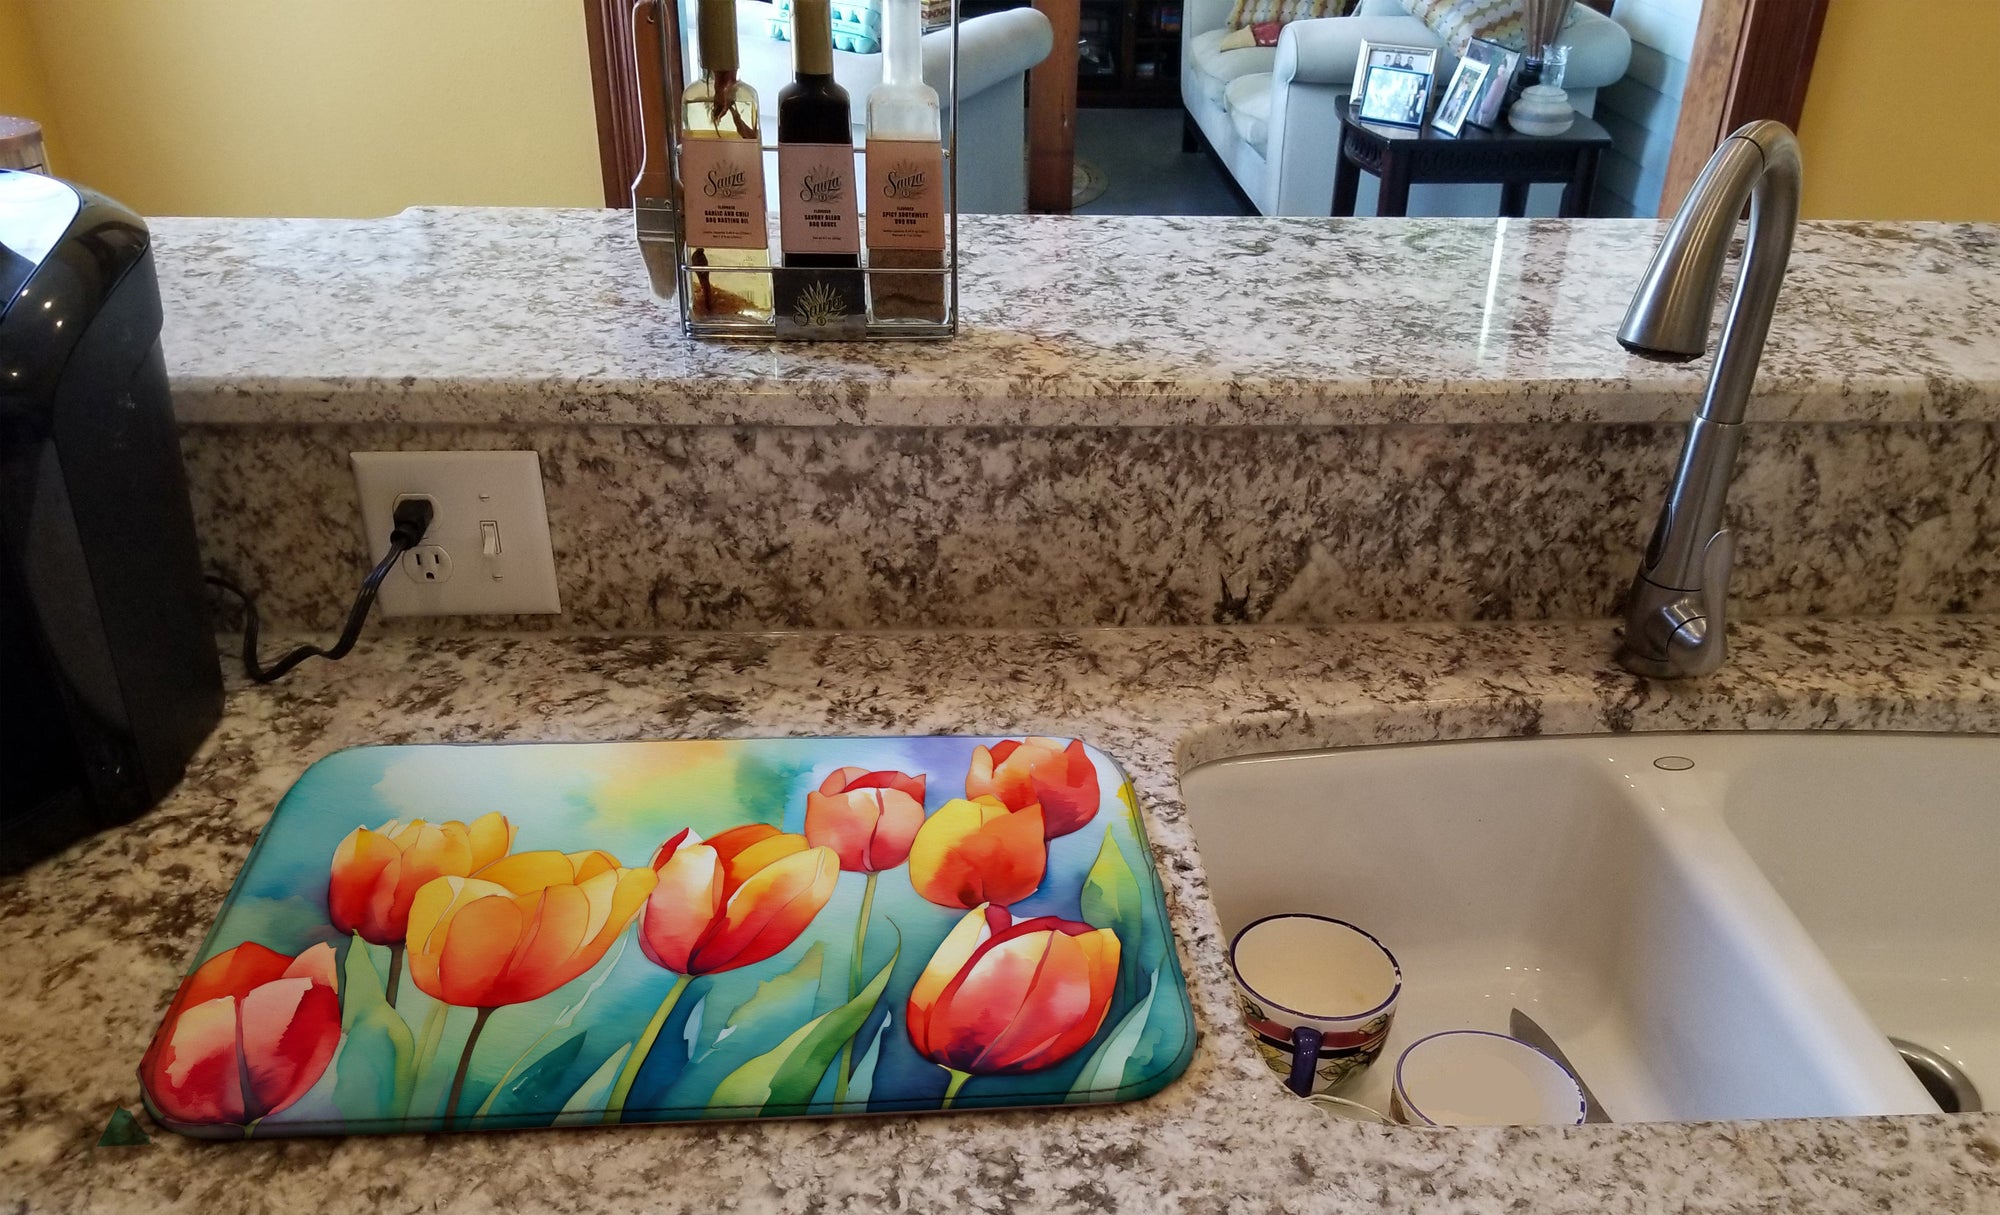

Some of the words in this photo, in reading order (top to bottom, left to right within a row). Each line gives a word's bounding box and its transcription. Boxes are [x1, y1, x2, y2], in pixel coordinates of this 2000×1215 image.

[704, 170, 745, 197] Sauza
[800, 176, 842, 202] Sauza
[884, 172, 926, 198] Sauza
